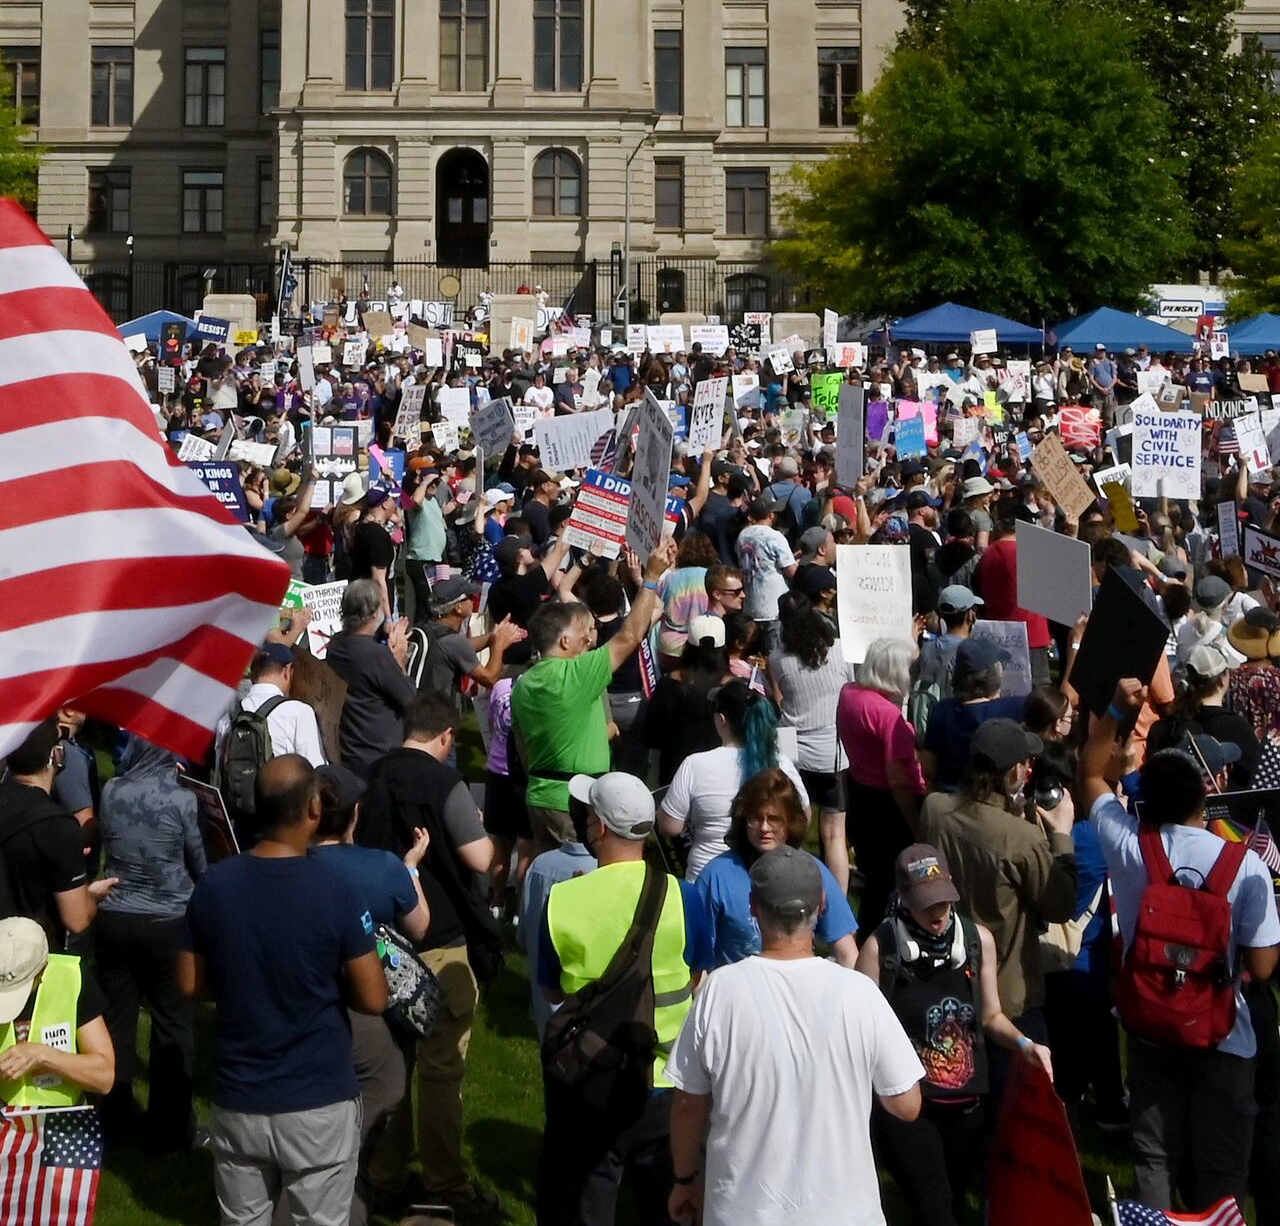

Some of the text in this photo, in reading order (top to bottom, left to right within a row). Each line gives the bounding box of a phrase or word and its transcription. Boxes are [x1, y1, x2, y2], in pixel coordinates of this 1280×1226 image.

[1162, 305, 1200, 313] PENSKE
[198, 322, 226, 337] RESIST.
[1205, 401, 1218, 419] NO
[1135, 414, 1201, 429] SOLIDARITY
[1150, 429, 1177, 441] WITH
[1142, 441, 1179, 453] CIVIL
[1136, 453, 1195, 468] SERVICE
[205, 468, 233, 479] KINGS
[209, 480, 220, 491] IN
[595, 474, 602, 486] I
[603, 478, 631, 496] DID
[216, 492, 237, 503] RICA
[304, 586, 344, 601] NO THRONE
